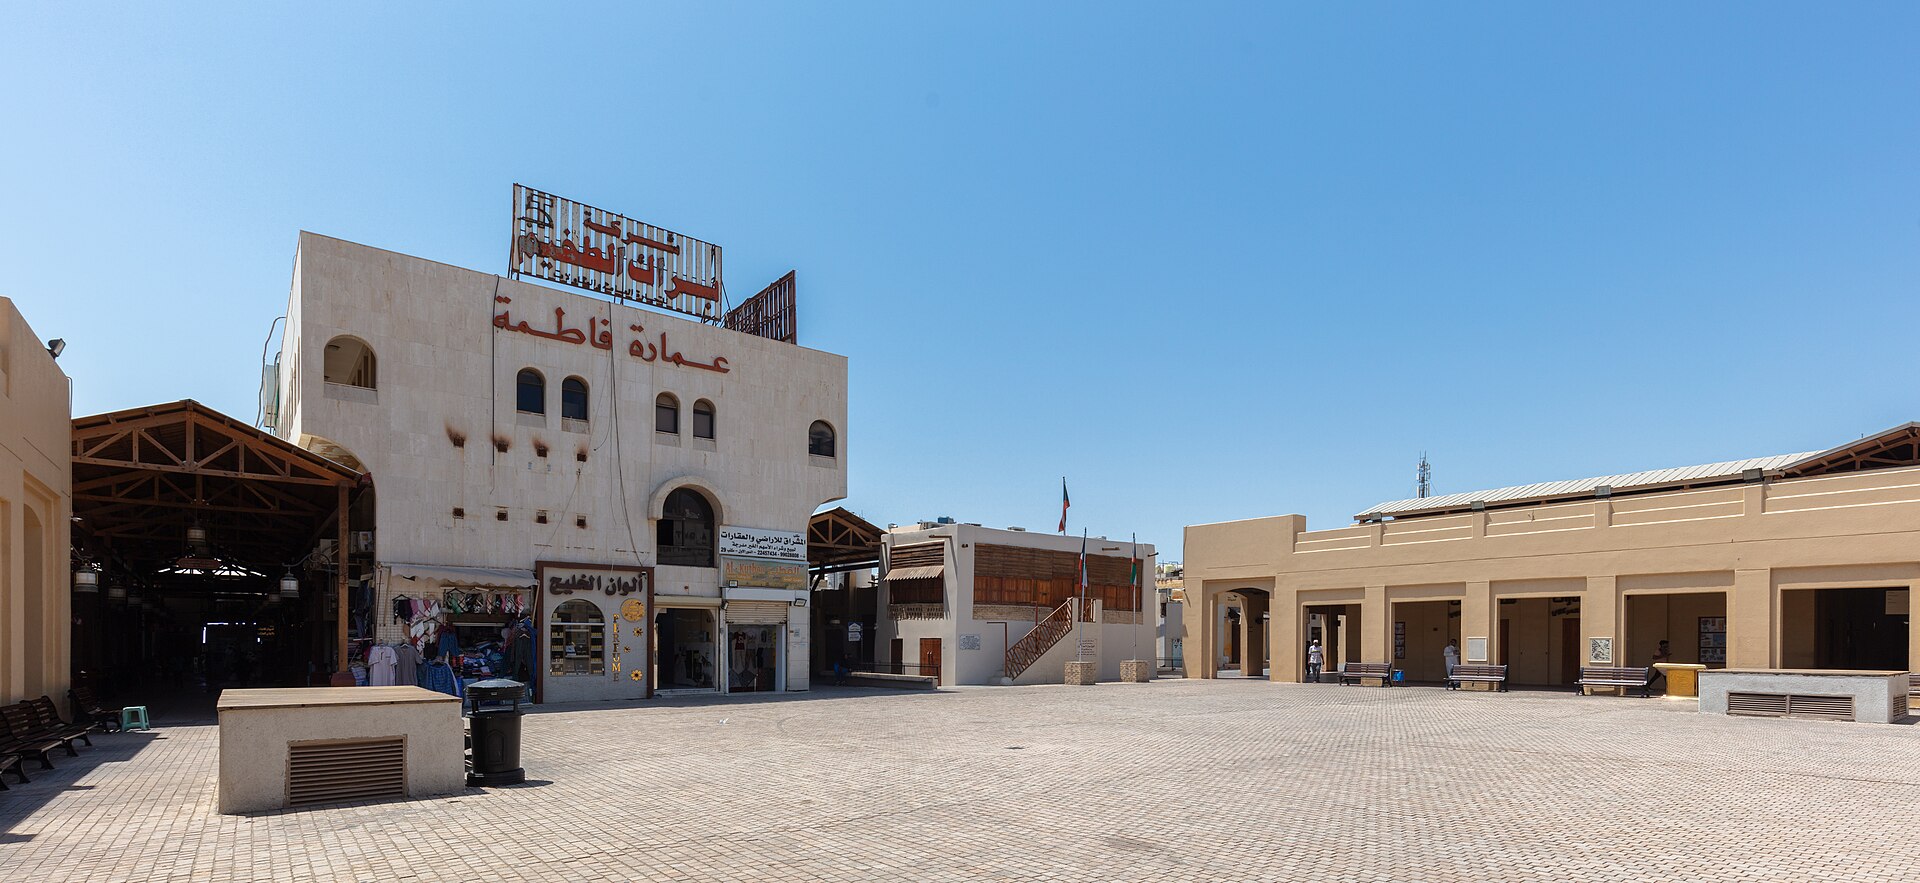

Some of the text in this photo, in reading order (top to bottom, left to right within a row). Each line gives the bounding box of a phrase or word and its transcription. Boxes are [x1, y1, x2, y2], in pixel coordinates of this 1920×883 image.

[493, 295, 731, 374] عمارة فاطمة
[550, 574, 602, 596] الخليج
[611, 613, 621, 682] PERFUME
